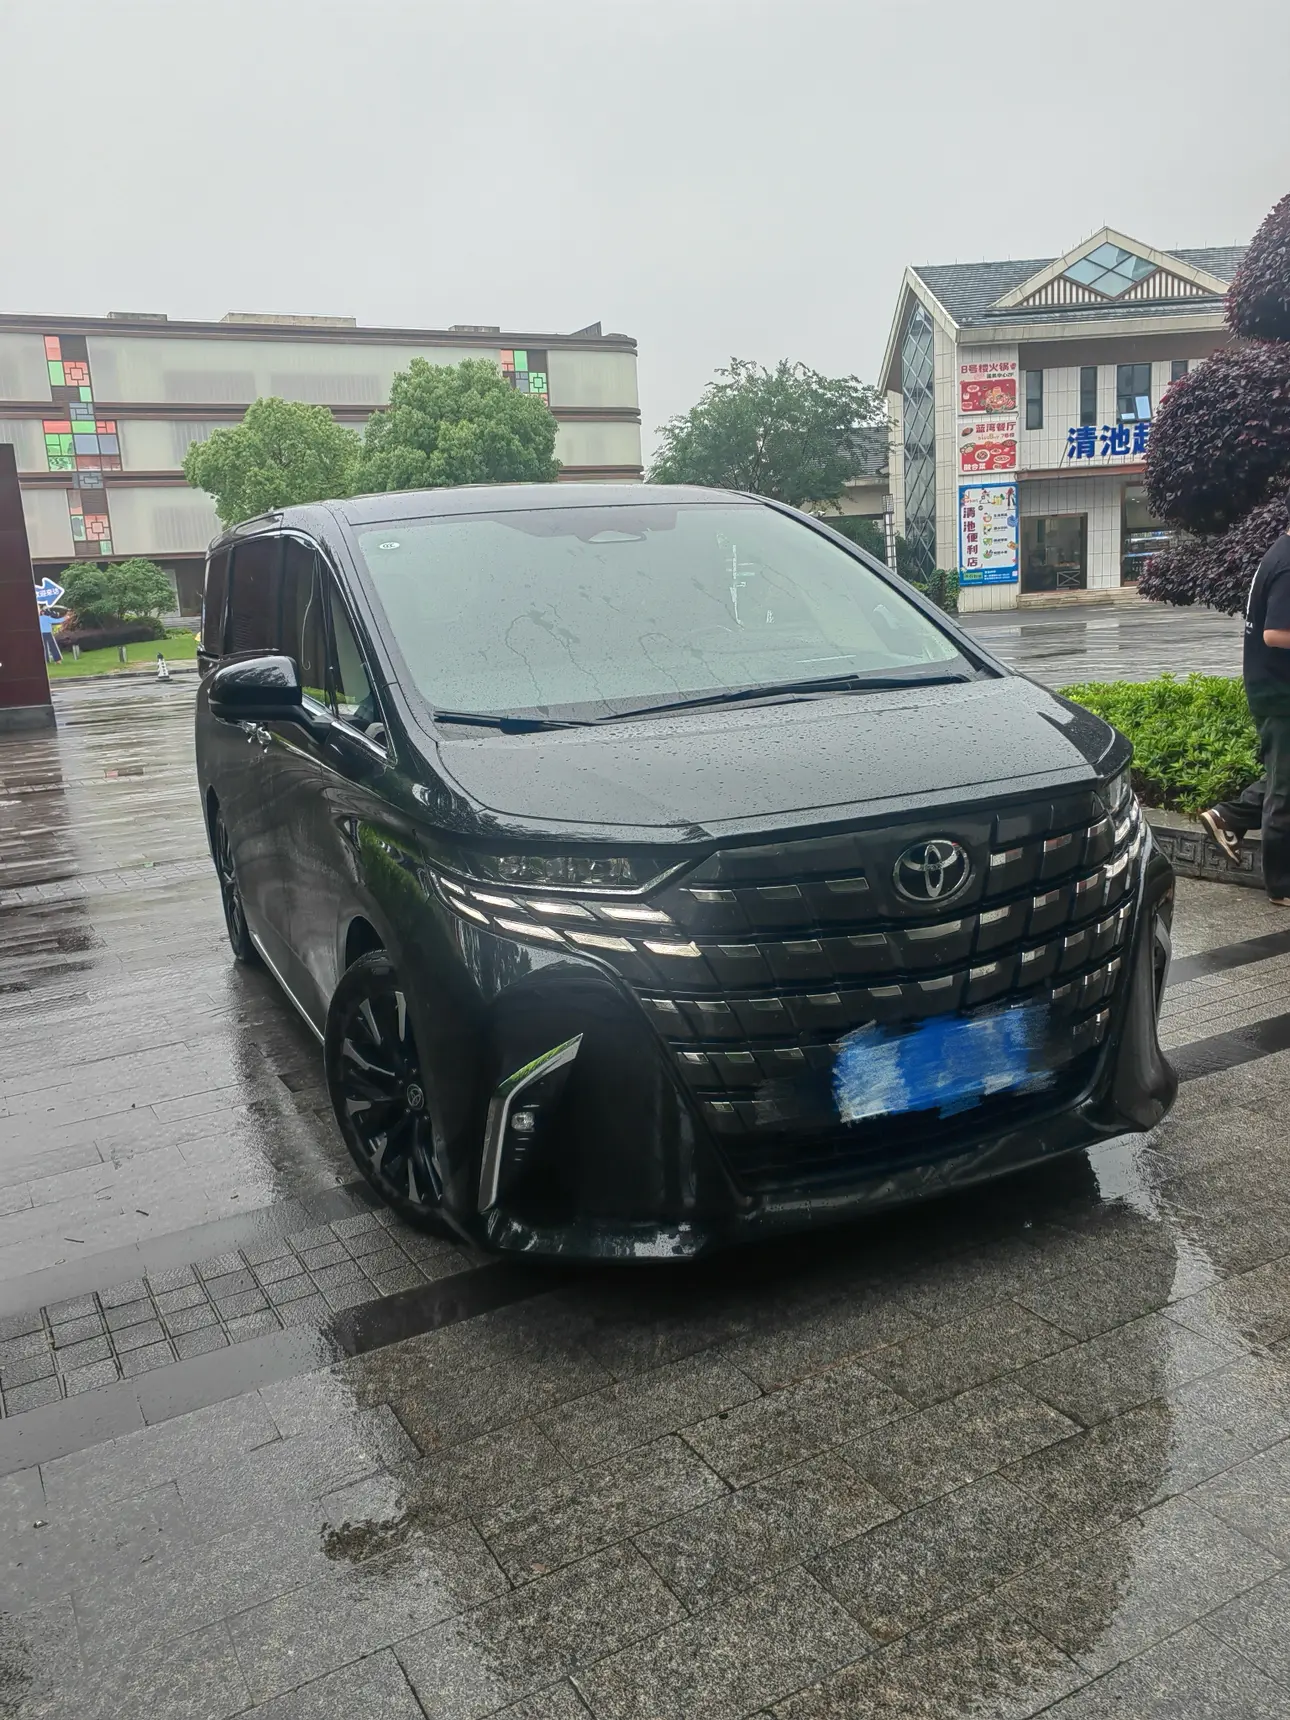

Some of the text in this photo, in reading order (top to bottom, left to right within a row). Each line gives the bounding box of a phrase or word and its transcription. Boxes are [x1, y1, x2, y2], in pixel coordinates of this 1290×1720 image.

[976, 421, 1016, 433] 蓝湾餐厅
[962, 507, 978, 568] 清池便利店
